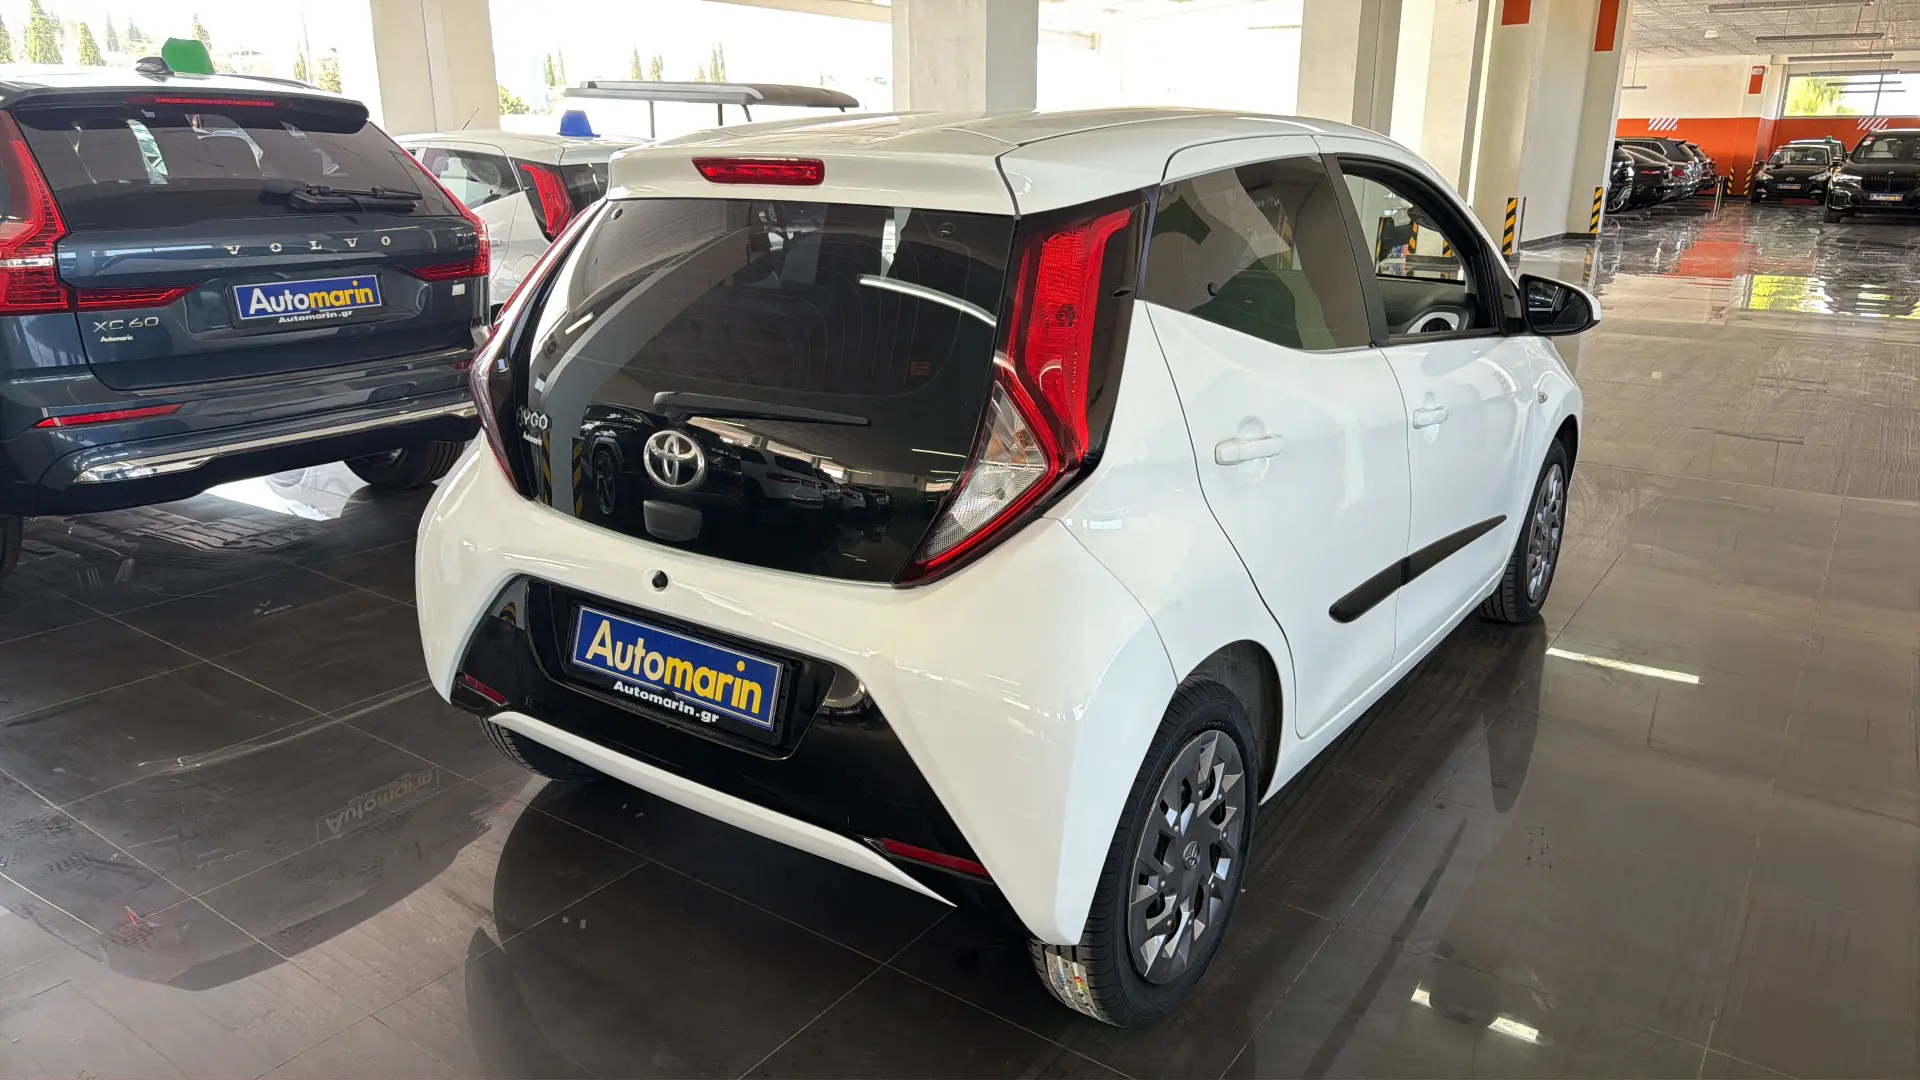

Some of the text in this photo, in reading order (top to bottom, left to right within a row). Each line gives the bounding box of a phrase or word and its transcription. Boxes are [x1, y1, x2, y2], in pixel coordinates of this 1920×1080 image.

[224, 236, 391, 254] VOLVO
[249, 280, 374, 314] Automarin
[278, 310, 353, 323] Automarin.gr
[585, 619, 762, 714] Automarin
[613, 680, 719, 723] Automarin.gr
